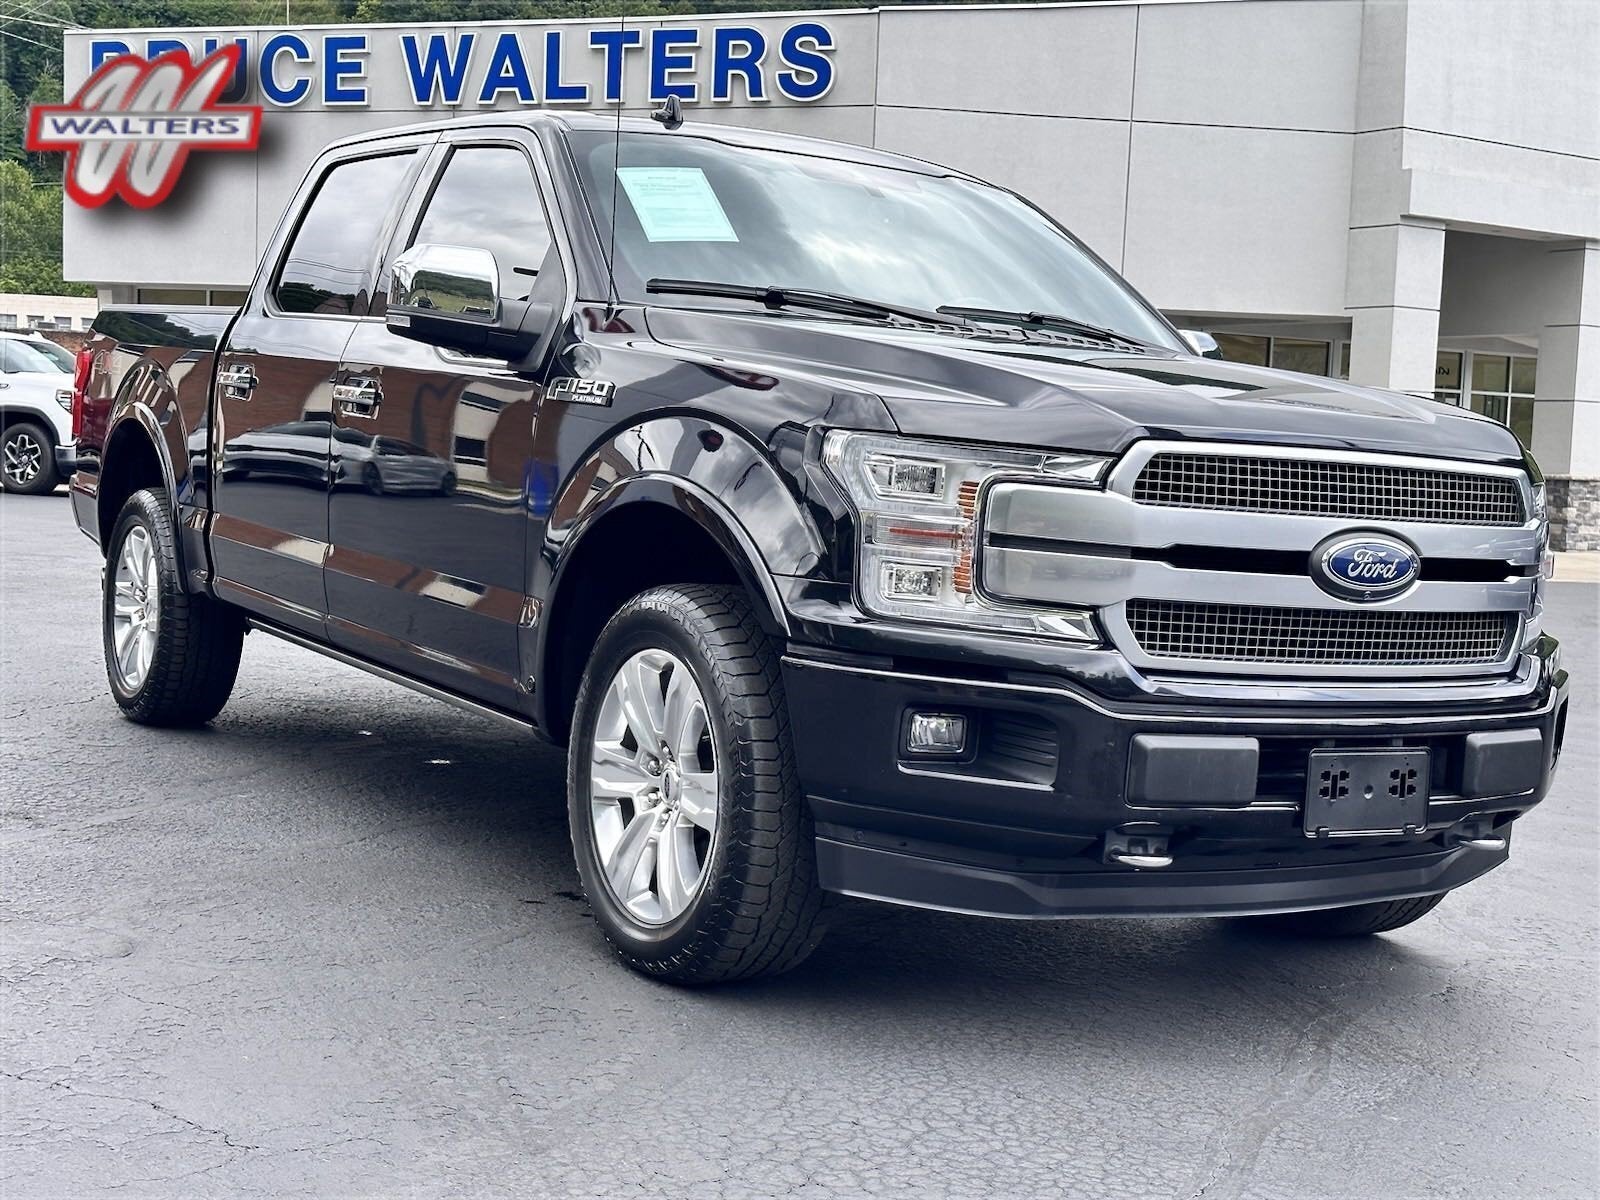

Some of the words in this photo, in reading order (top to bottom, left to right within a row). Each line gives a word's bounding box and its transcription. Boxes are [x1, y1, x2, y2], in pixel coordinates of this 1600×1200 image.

[399, 21, 836, 106] WALTERS
[571, 394, 603, 405] PLATINUM
[1347, 548, 1399, 578] Ford
